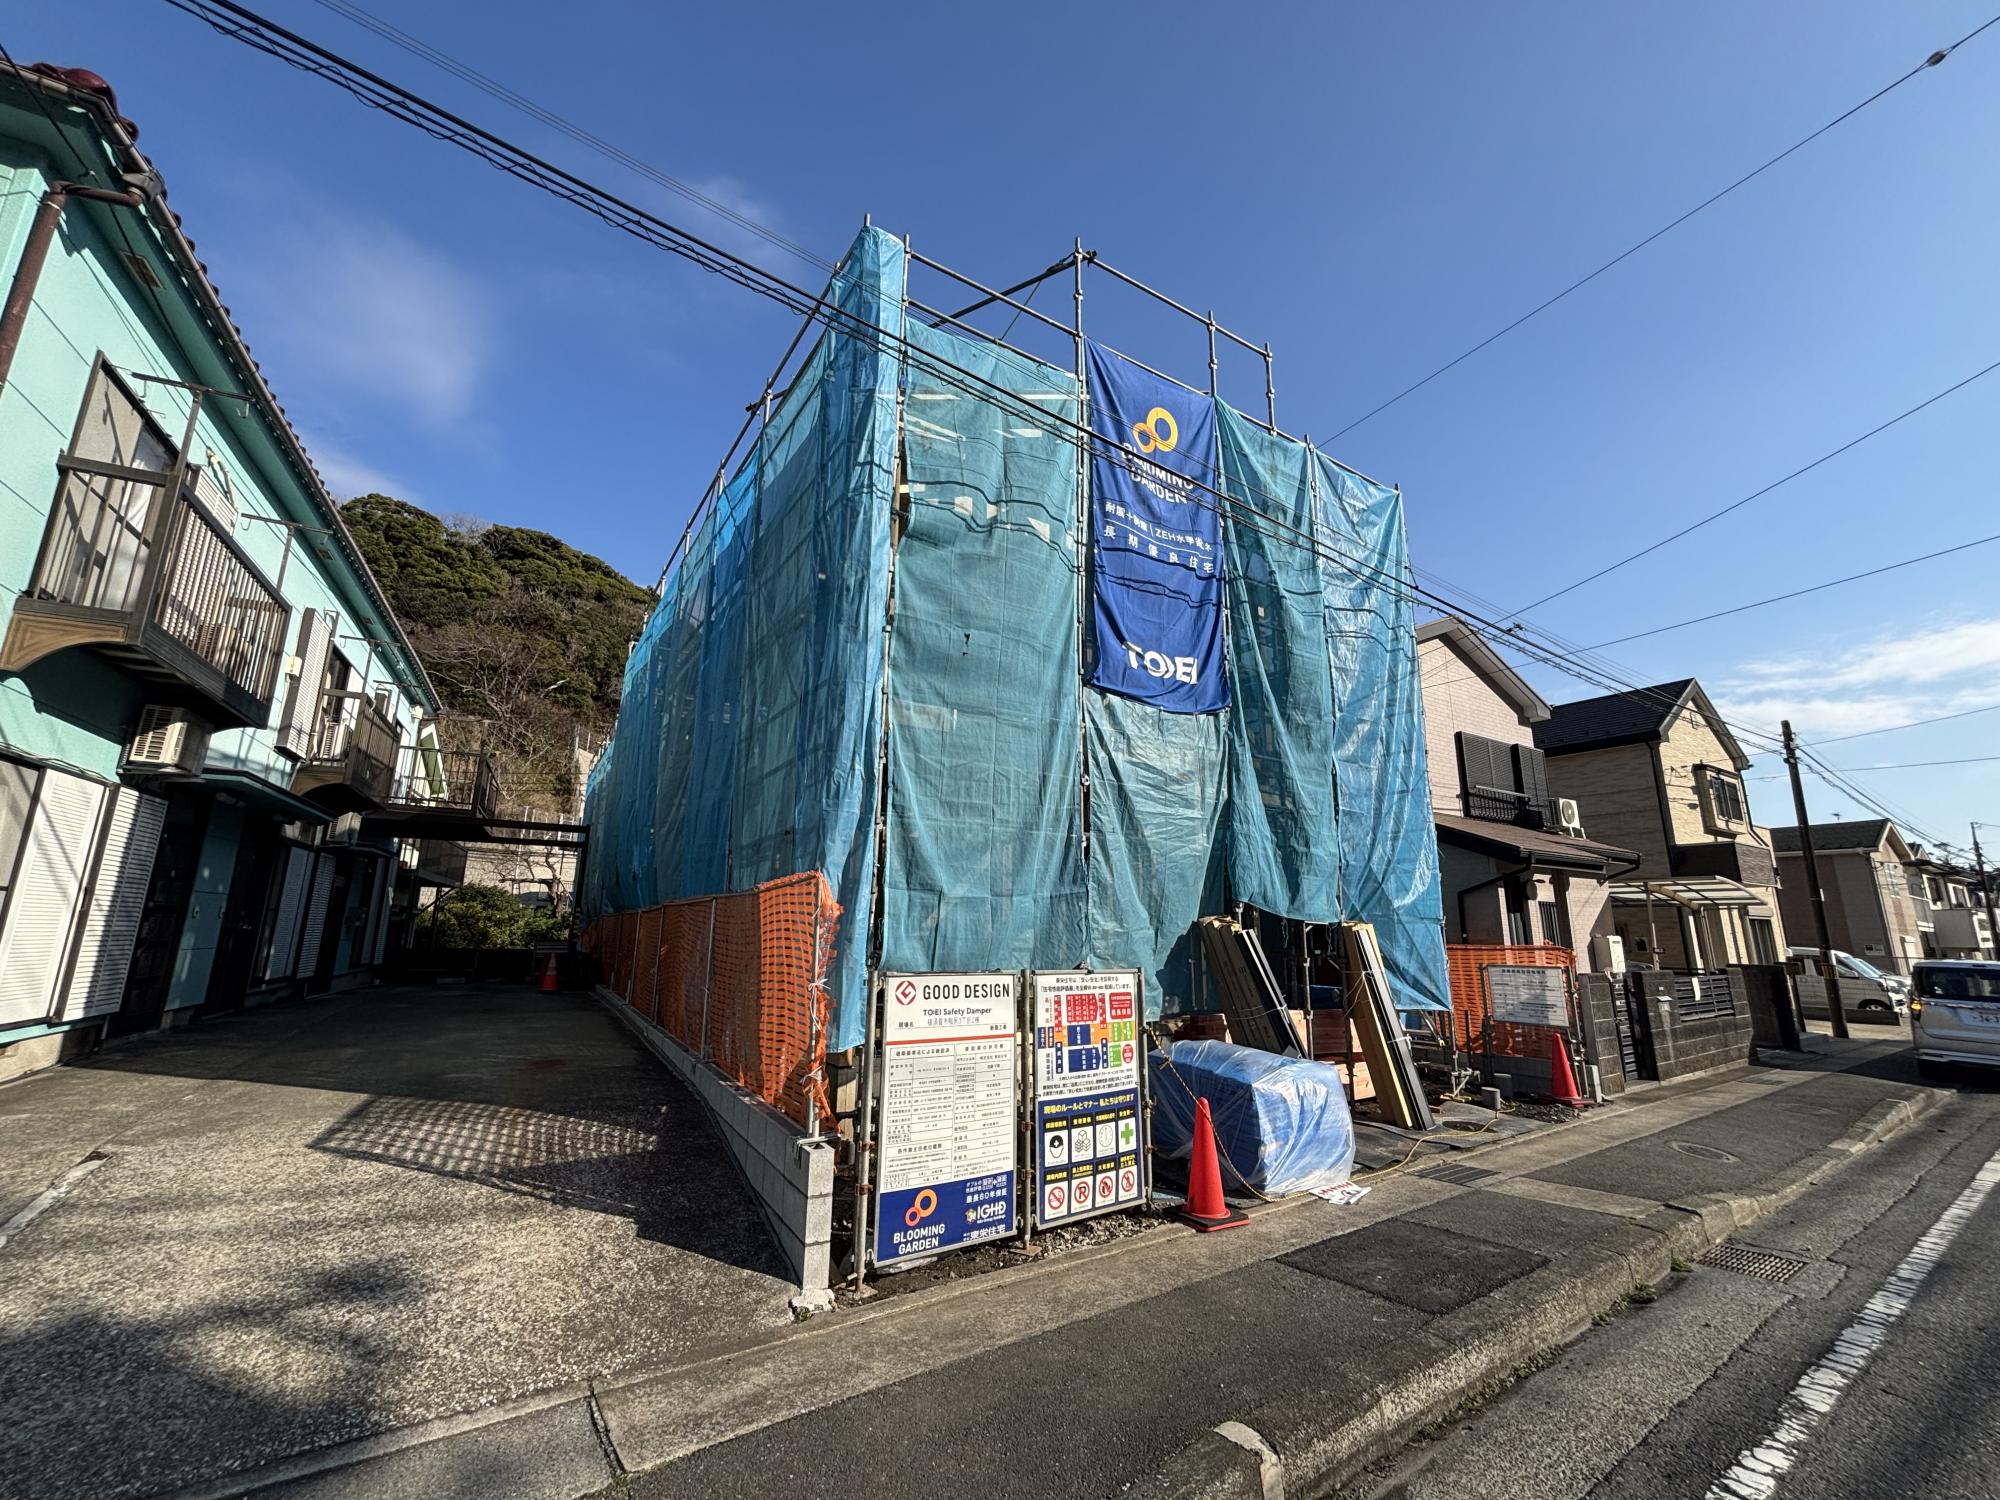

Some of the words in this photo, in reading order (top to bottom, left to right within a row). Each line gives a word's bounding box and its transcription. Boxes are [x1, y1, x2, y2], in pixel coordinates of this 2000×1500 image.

[1104, 525, 1215, 574] 長期優良住宅
[923, 984, 960, 1000] GOOD
[964, 983, 1010, 999] DESIGN
[943, 1008, 965, 1017] Safety
[966, 1007, 992, 1016] Damper
[1043, 1101, 1098, 1114] 現場のルールとマナー
[966, 1187, 1008, 1203] 最長60年保証
[977, 1201, 1007, 1220] IGHD
[893, 1223, 946, 1244] BLOOMING
[970, 1224, 1006, 1240] 東栄住宅
[898, 1236, 939, 1255] GARDEN
